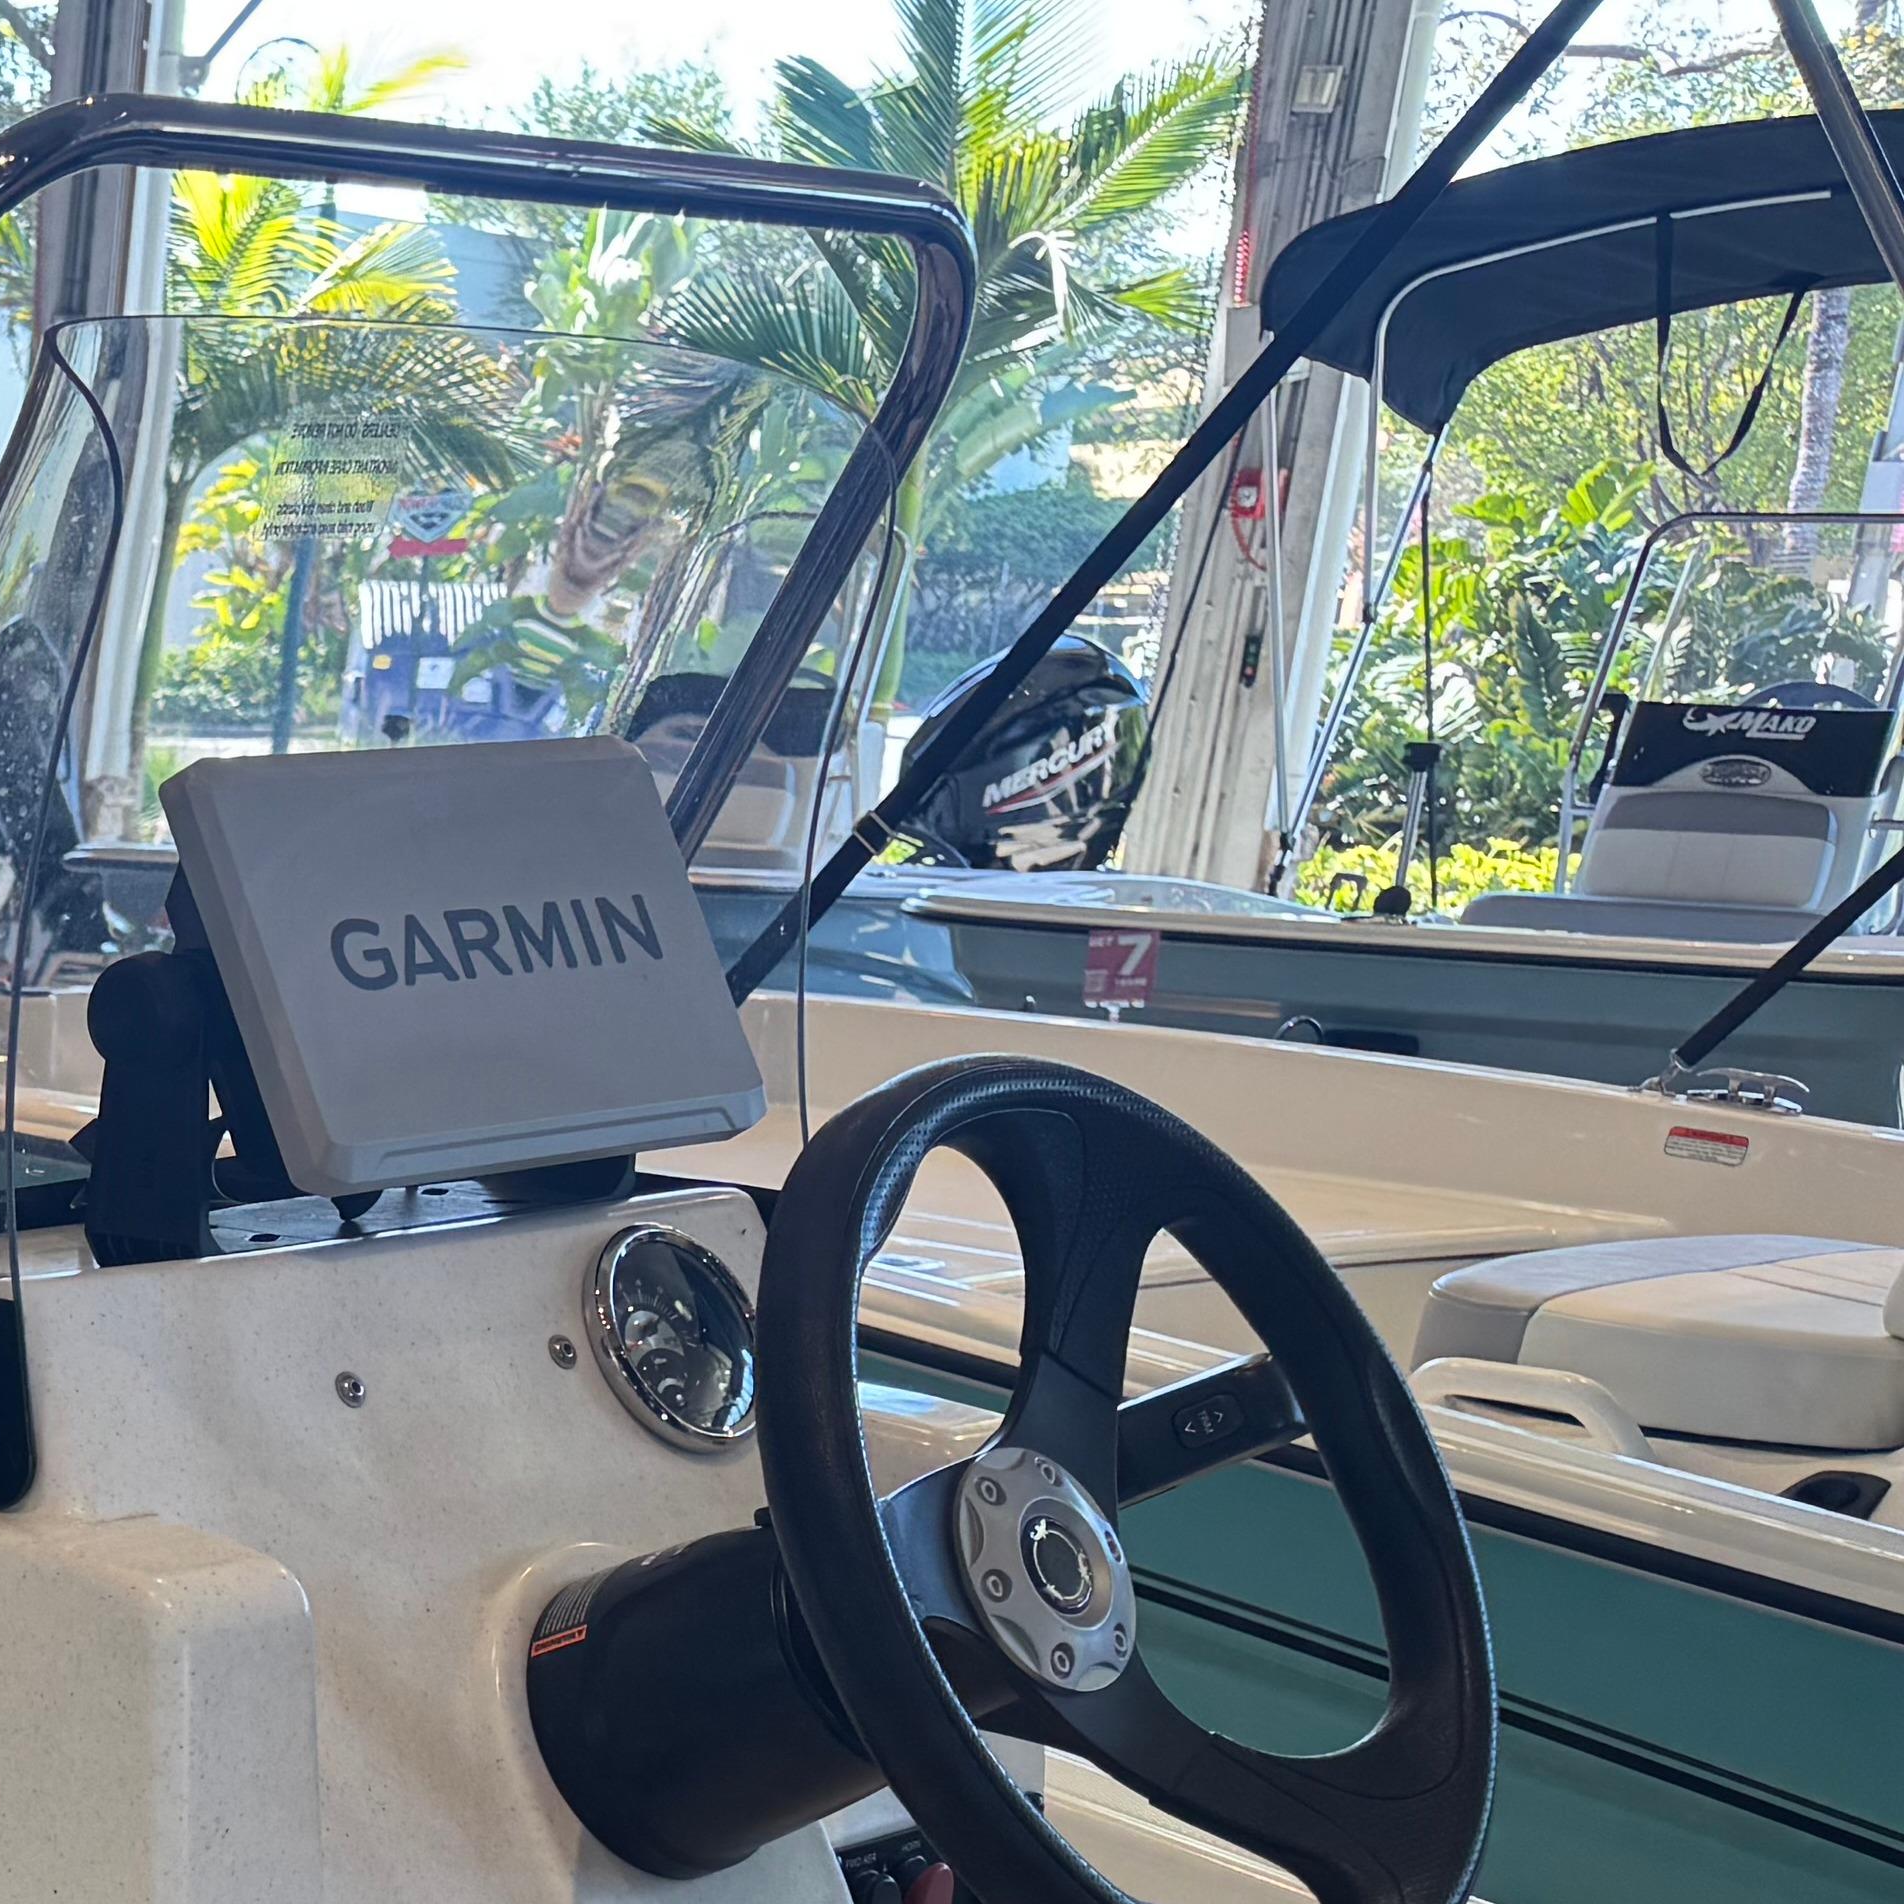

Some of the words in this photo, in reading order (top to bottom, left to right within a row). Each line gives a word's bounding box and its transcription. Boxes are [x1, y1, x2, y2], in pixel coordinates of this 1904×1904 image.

[1738, 711, 1817, 741] MAKO
[330, 894, 664, 991] GARMIN
[1118, 933, 1153, 976] 7
